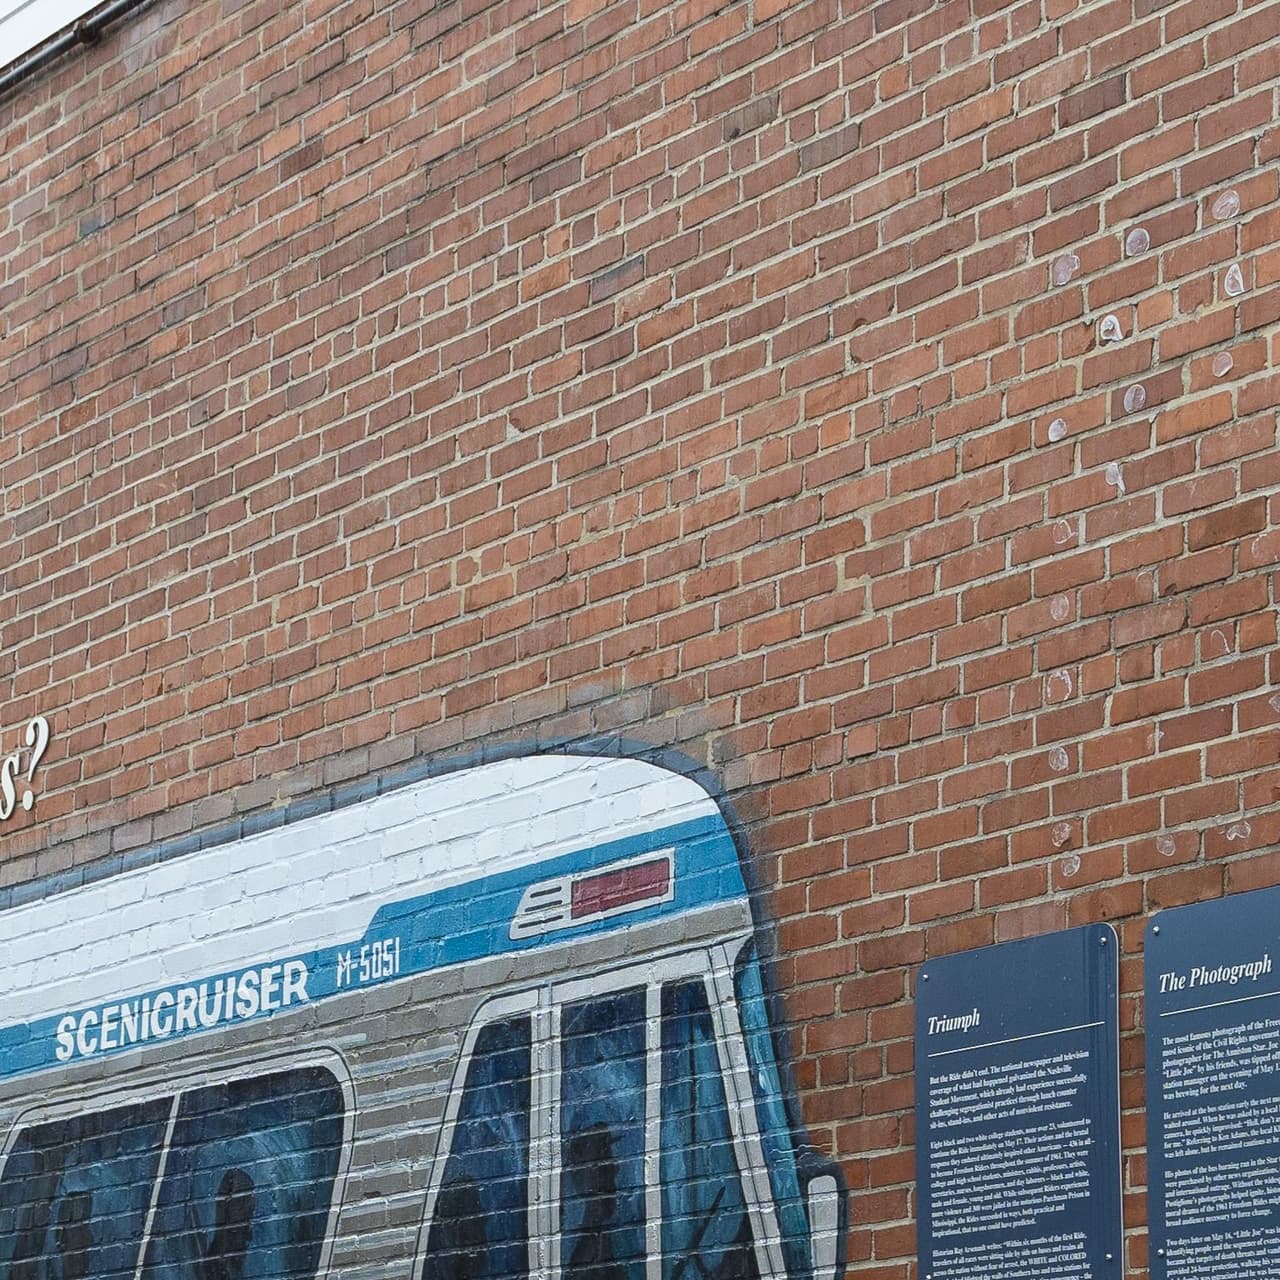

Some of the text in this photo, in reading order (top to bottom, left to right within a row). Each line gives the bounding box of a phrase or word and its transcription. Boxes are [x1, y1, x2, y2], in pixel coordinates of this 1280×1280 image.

[336, 936, 400, 988] M-5051
[1160, 954, 1272, 993] The Photograph
[55, 959, 310, 1061] SCENICRUISER
[928, 1009, 980, 1035] Triumph
